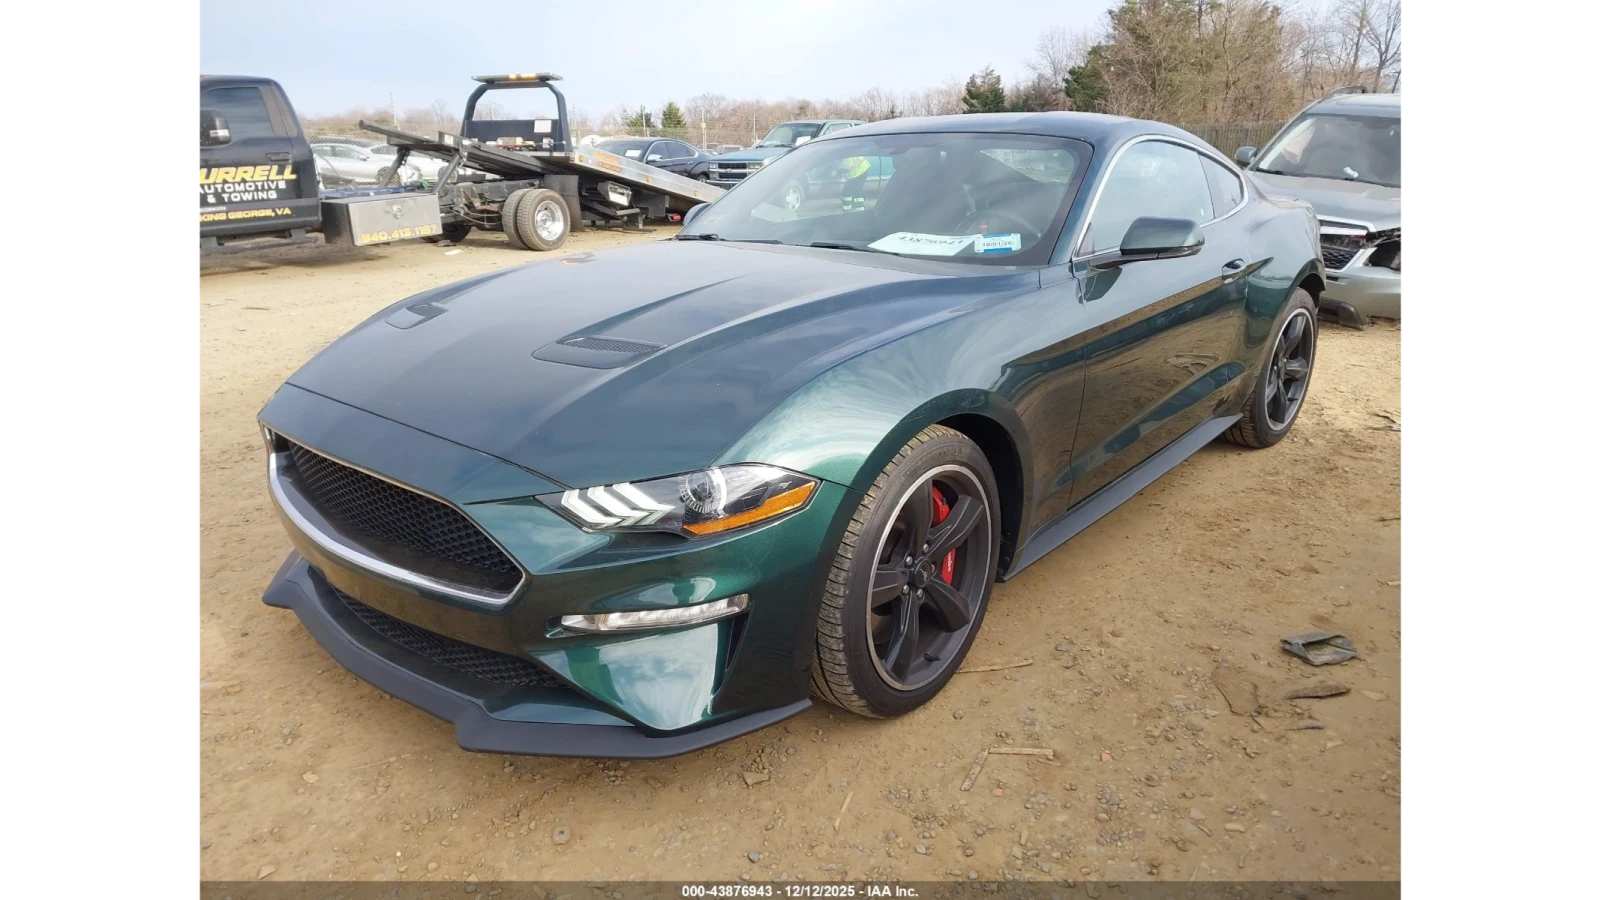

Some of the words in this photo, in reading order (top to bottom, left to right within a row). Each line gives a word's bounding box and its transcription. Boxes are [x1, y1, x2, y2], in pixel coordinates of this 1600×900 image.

[207, 195, 216, 203] &
[222, 190, 278, 202] TOWING
[199, 212, 227, 222] KING
[228, 208, 275, 219] GEORGE,
[276, 207, 292, 215] VA
